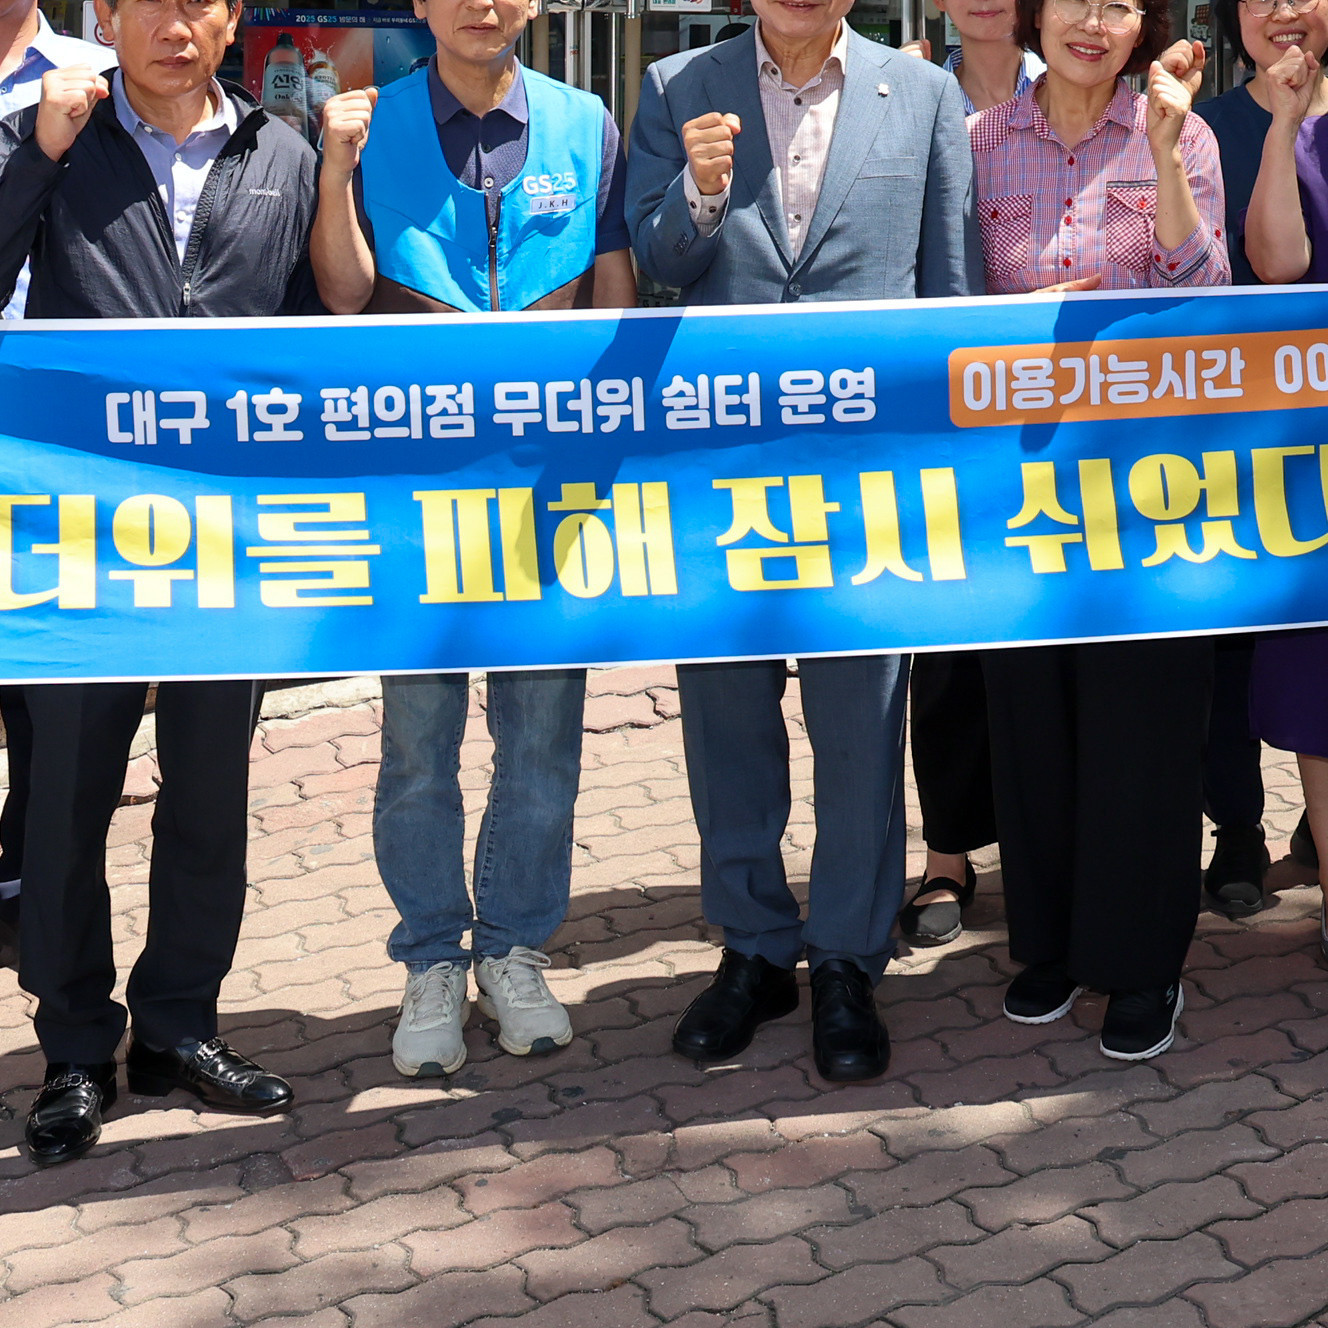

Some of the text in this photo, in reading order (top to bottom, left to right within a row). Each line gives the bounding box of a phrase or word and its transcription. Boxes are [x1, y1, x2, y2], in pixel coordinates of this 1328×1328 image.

[295, 14, 316, 23] 2025
[317, 15, 337, 23] GS25
[522, 171, 577, 195] GS25
[105, 366, 878, 446] 대구 1호 편의점 무더위 쉼터 운영
[962, 348, 1245, 412] 이용가능시간
[412, 480, 679, 604] 피해
[711, 466, 968, 593] 잠시
